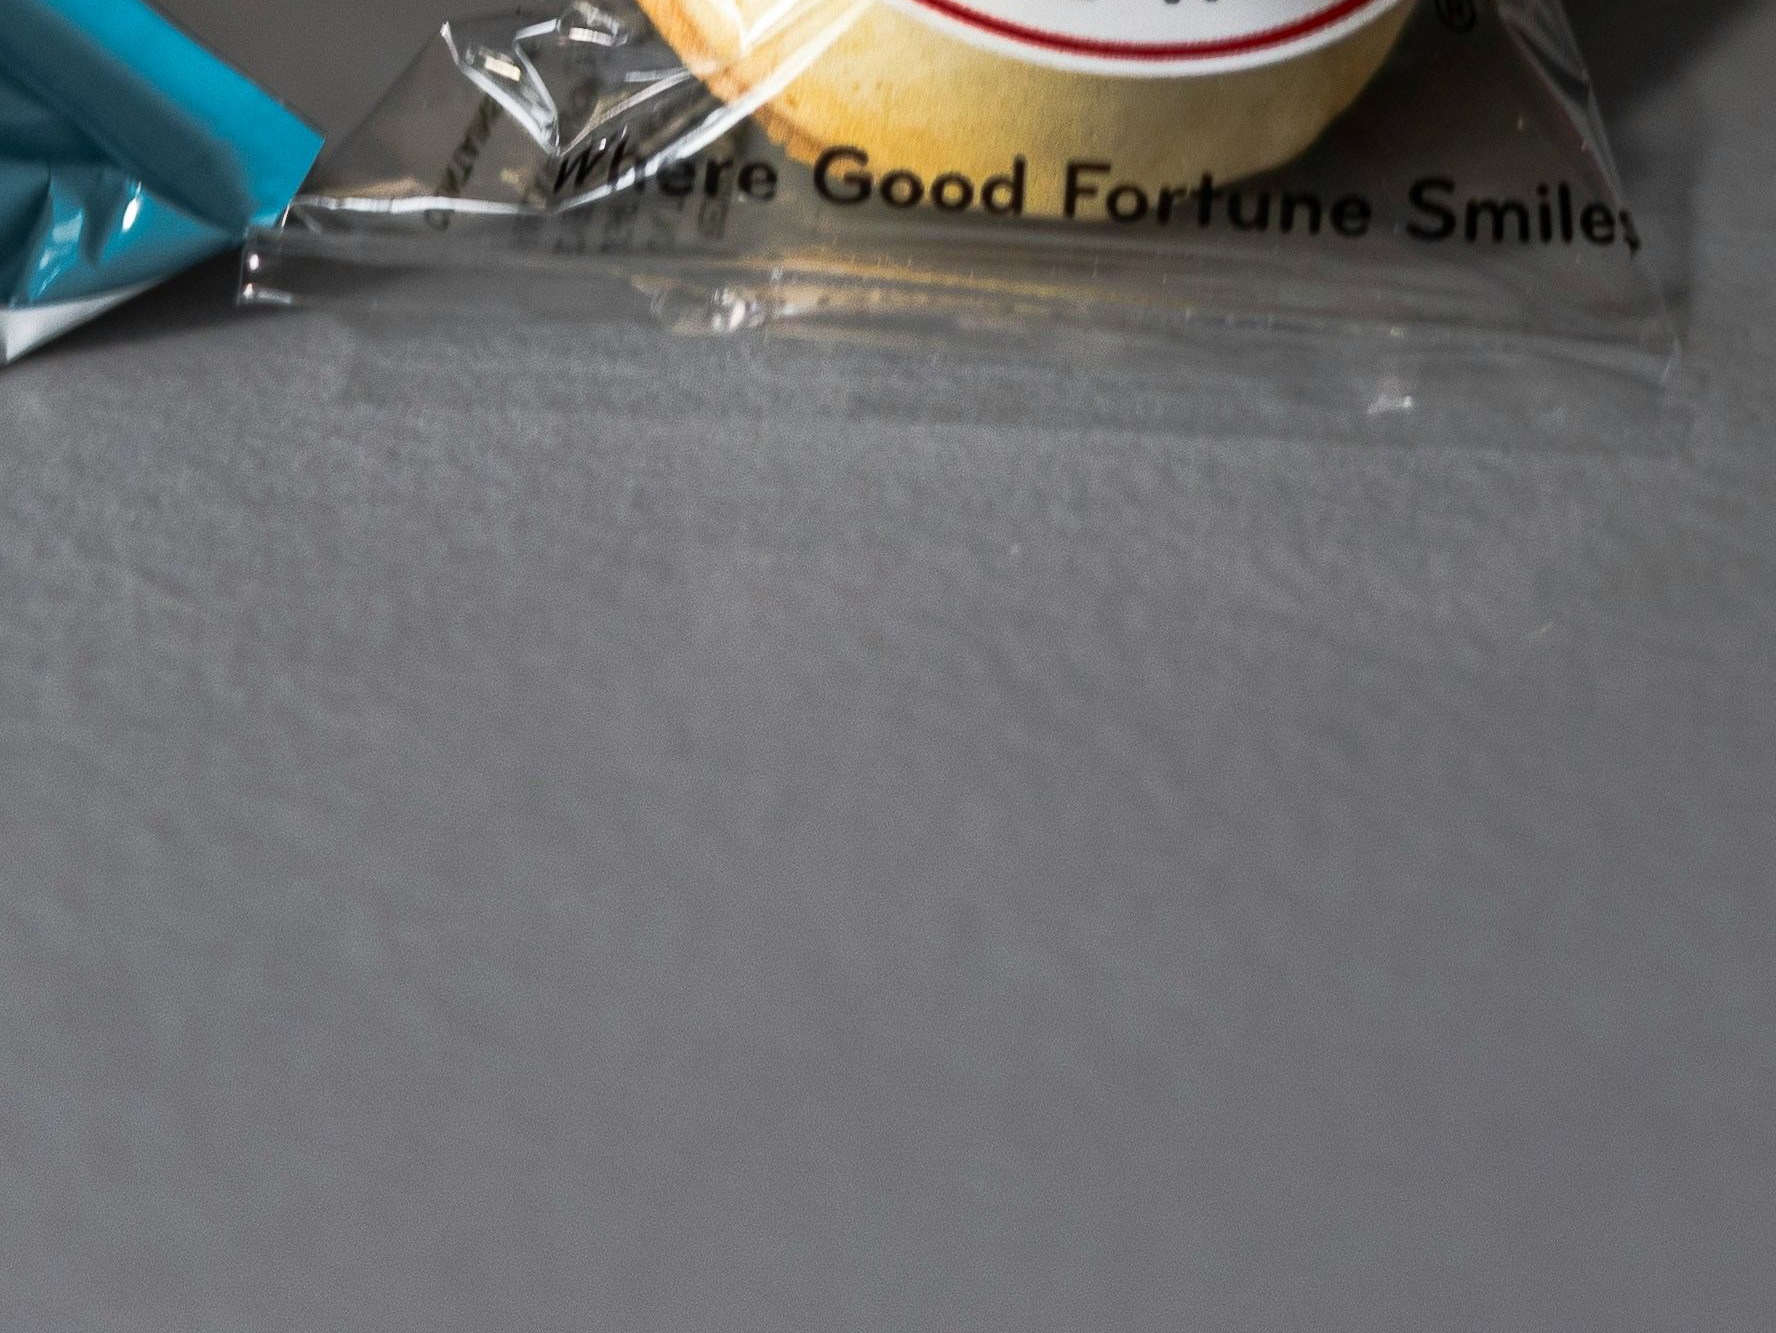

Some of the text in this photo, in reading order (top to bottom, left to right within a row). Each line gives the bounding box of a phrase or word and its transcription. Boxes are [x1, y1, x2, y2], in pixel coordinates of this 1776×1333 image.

[552, 126, 779, 201] Where
[811, 140, 1026, 218] Good
[1062, 160, 1373, 241] Fortune
